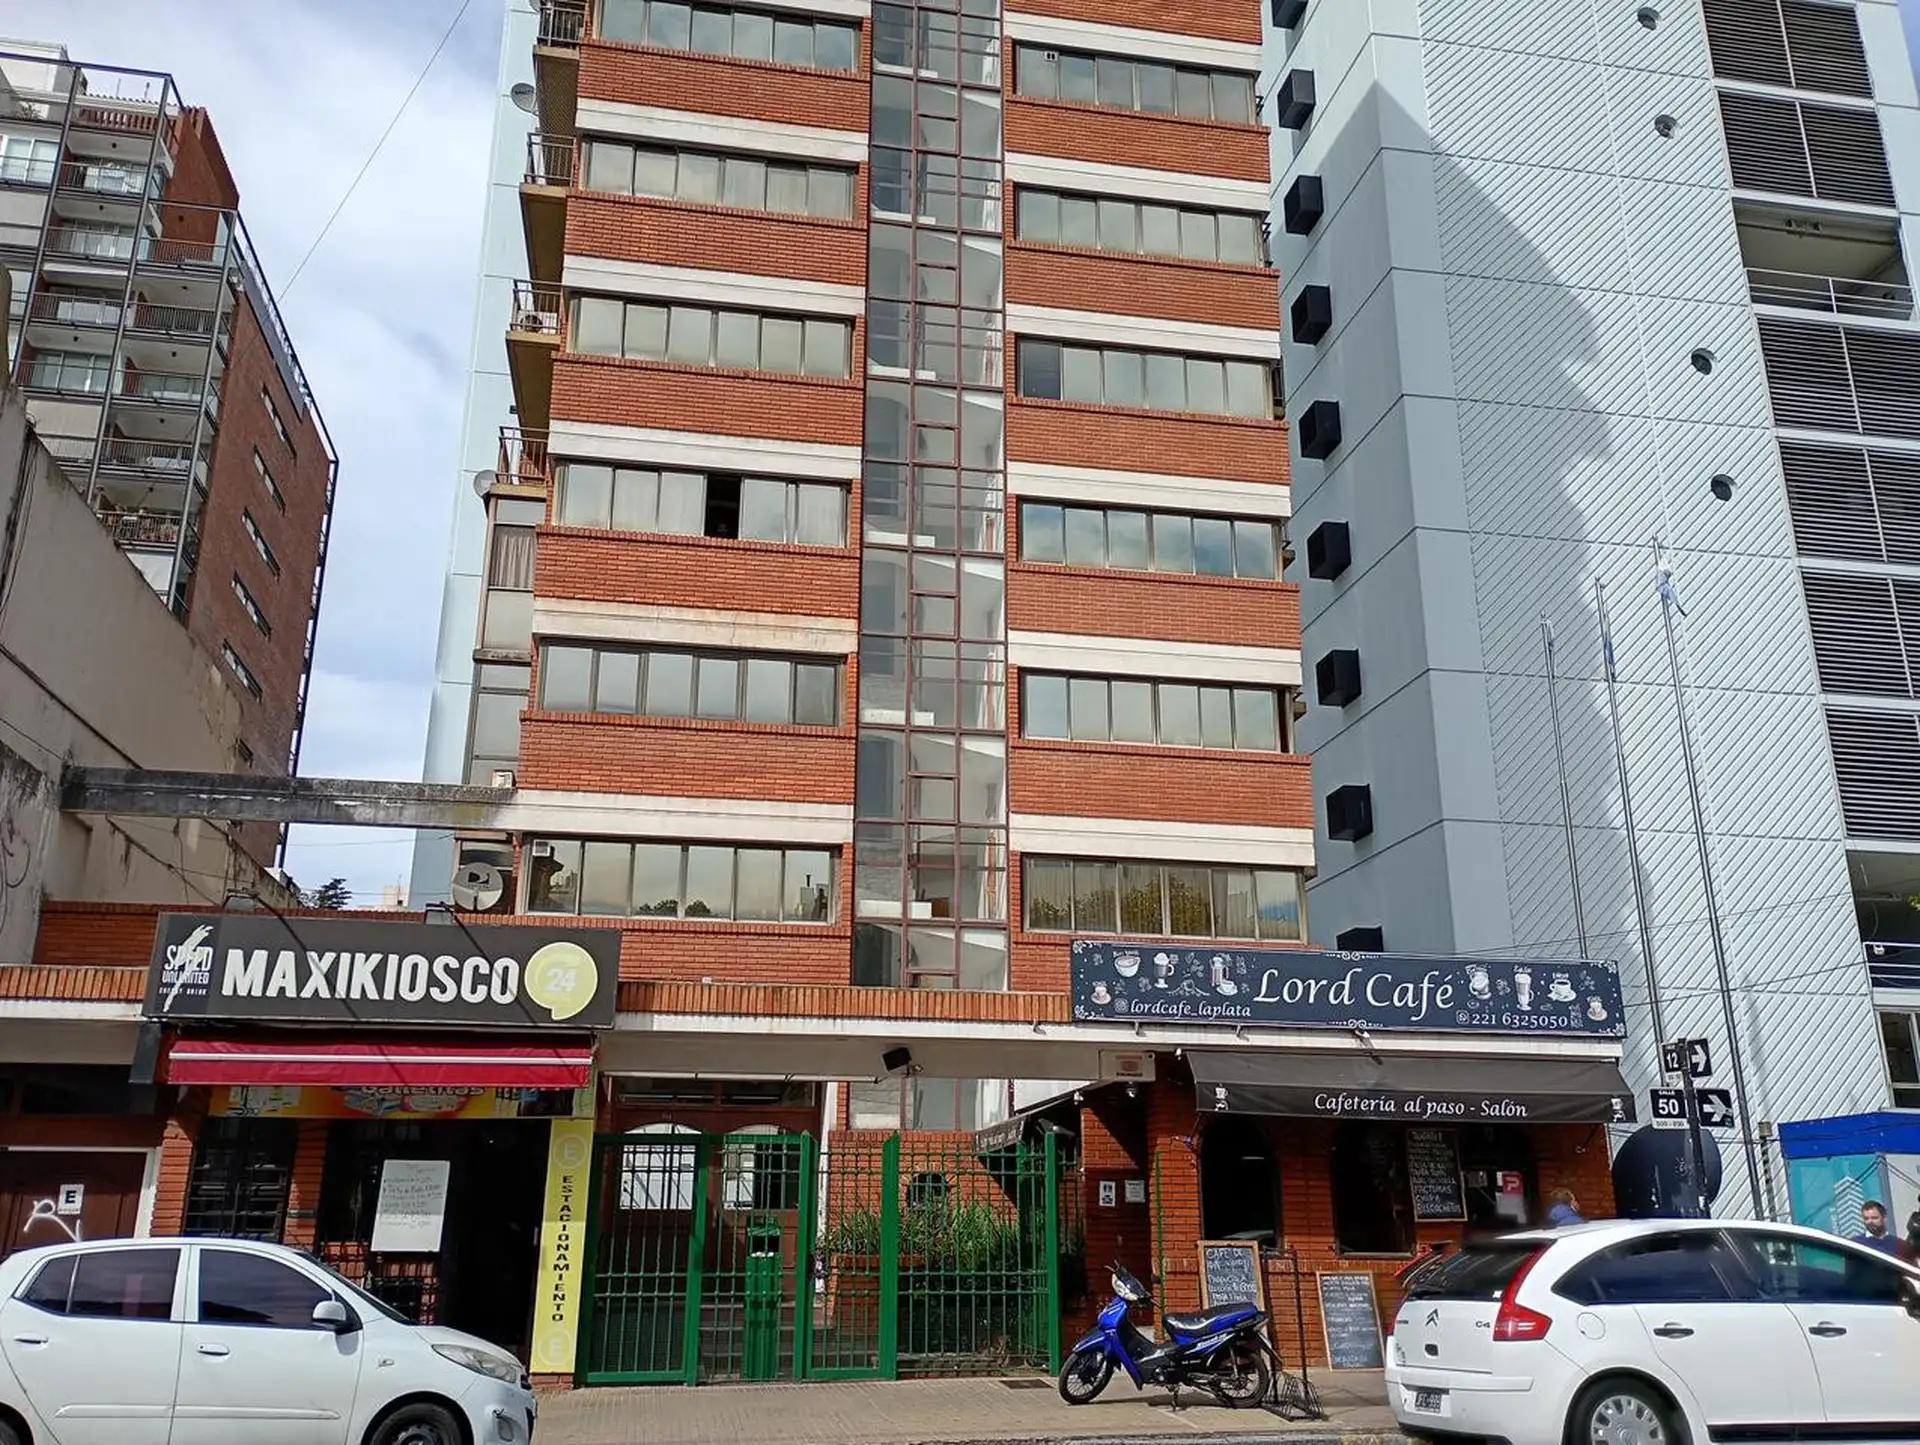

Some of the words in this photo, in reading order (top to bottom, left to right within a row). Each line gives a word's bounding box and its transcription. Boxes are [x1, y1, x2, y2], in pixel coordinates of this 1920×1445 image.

[222, 948, 520, 1005] MAXIKIOSCO
[545, 967, 579, 991] 24
[1253, 967, 1363, 1005] Lord
[1364, 970, 1455, 1022] Café
[1130, 999, 1251, 1020] lordcafe_laplata
[1471, 1014, 1497, 1025] 221
[1502, 1012, 1568, 1029] 6325050
[1666, 1052, 1679, 1069] 12
[1314, 1092, 1396, 1115] Cafetería
[1404, 1095, 1424, 1113] al
[1423, 1103, 1465, 1119] paso
[1480, 1099, 1529, 1117] Salón
[1658, 1099, 1679, 1115] 50
[64, 1190, 77, 1205] E
[552, 1175, 574, 1322] ESTACIONAMIENTO
[1475, 1321, 1491, 1329] C4
